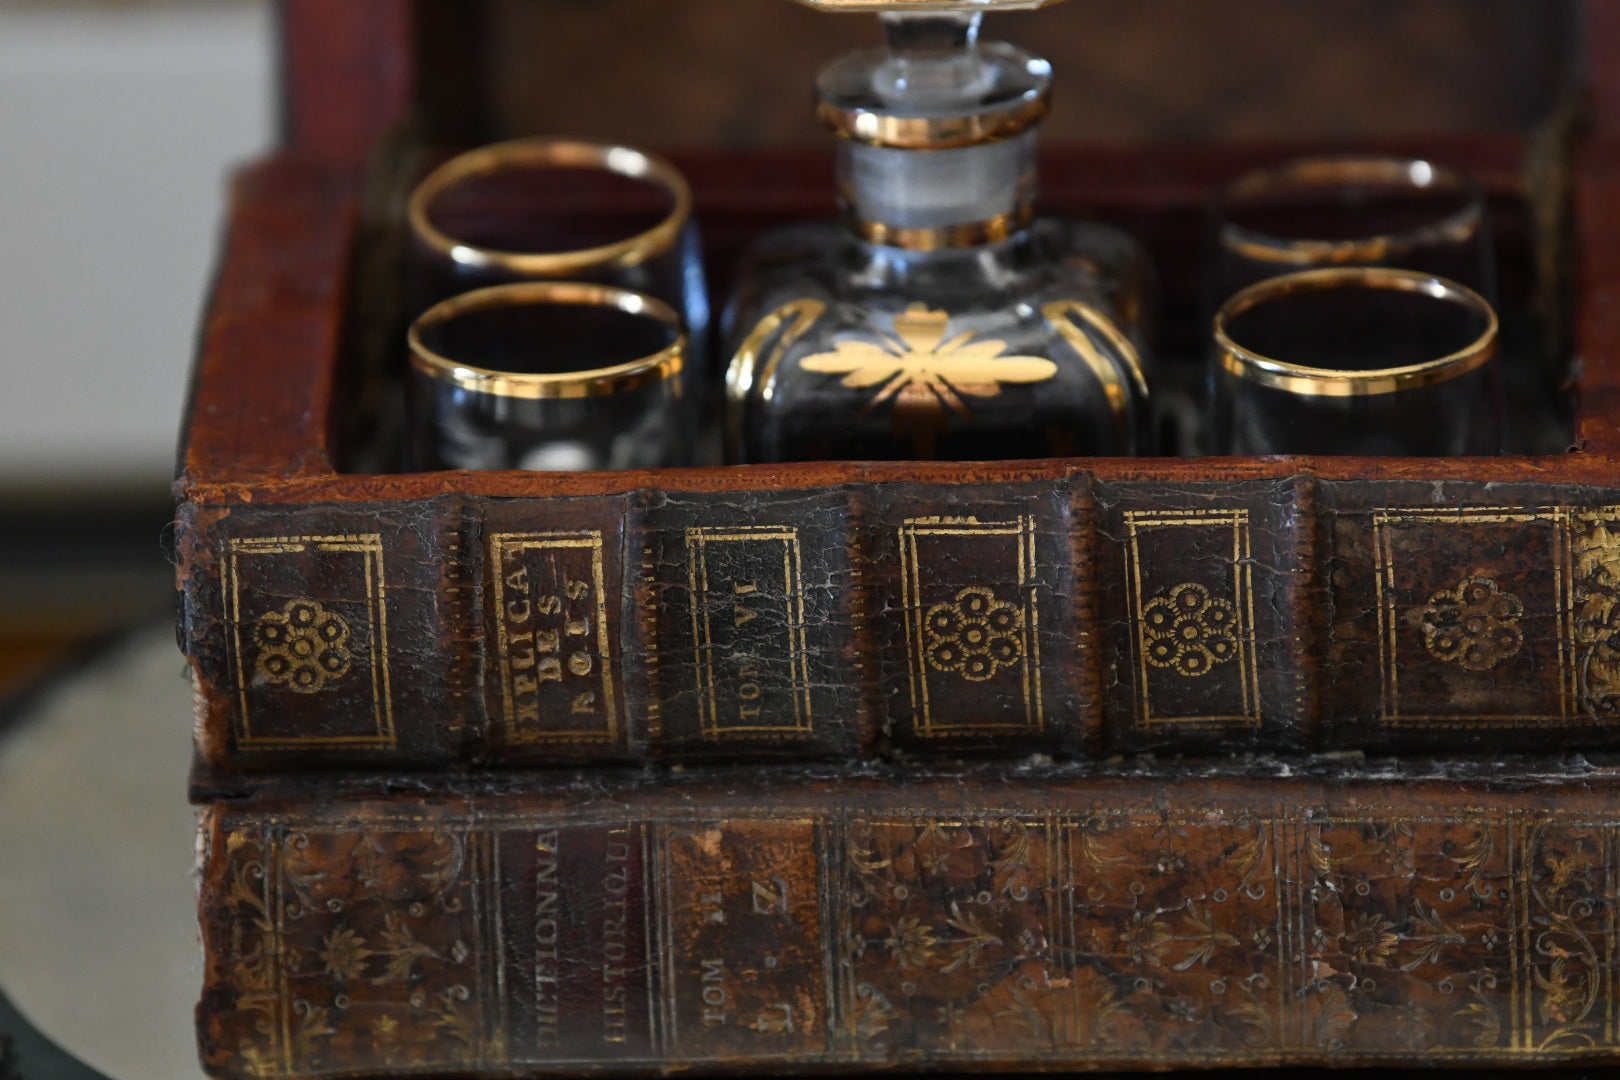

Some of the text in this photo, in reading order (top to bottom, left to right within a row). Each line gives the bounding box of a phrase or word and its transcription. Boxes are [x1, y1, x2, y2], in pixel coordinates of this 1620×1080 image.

[535, 595, 562, 682] DES
[752, 876, 789, 916] Z
[701, 891, 726, 1027] TOM II
